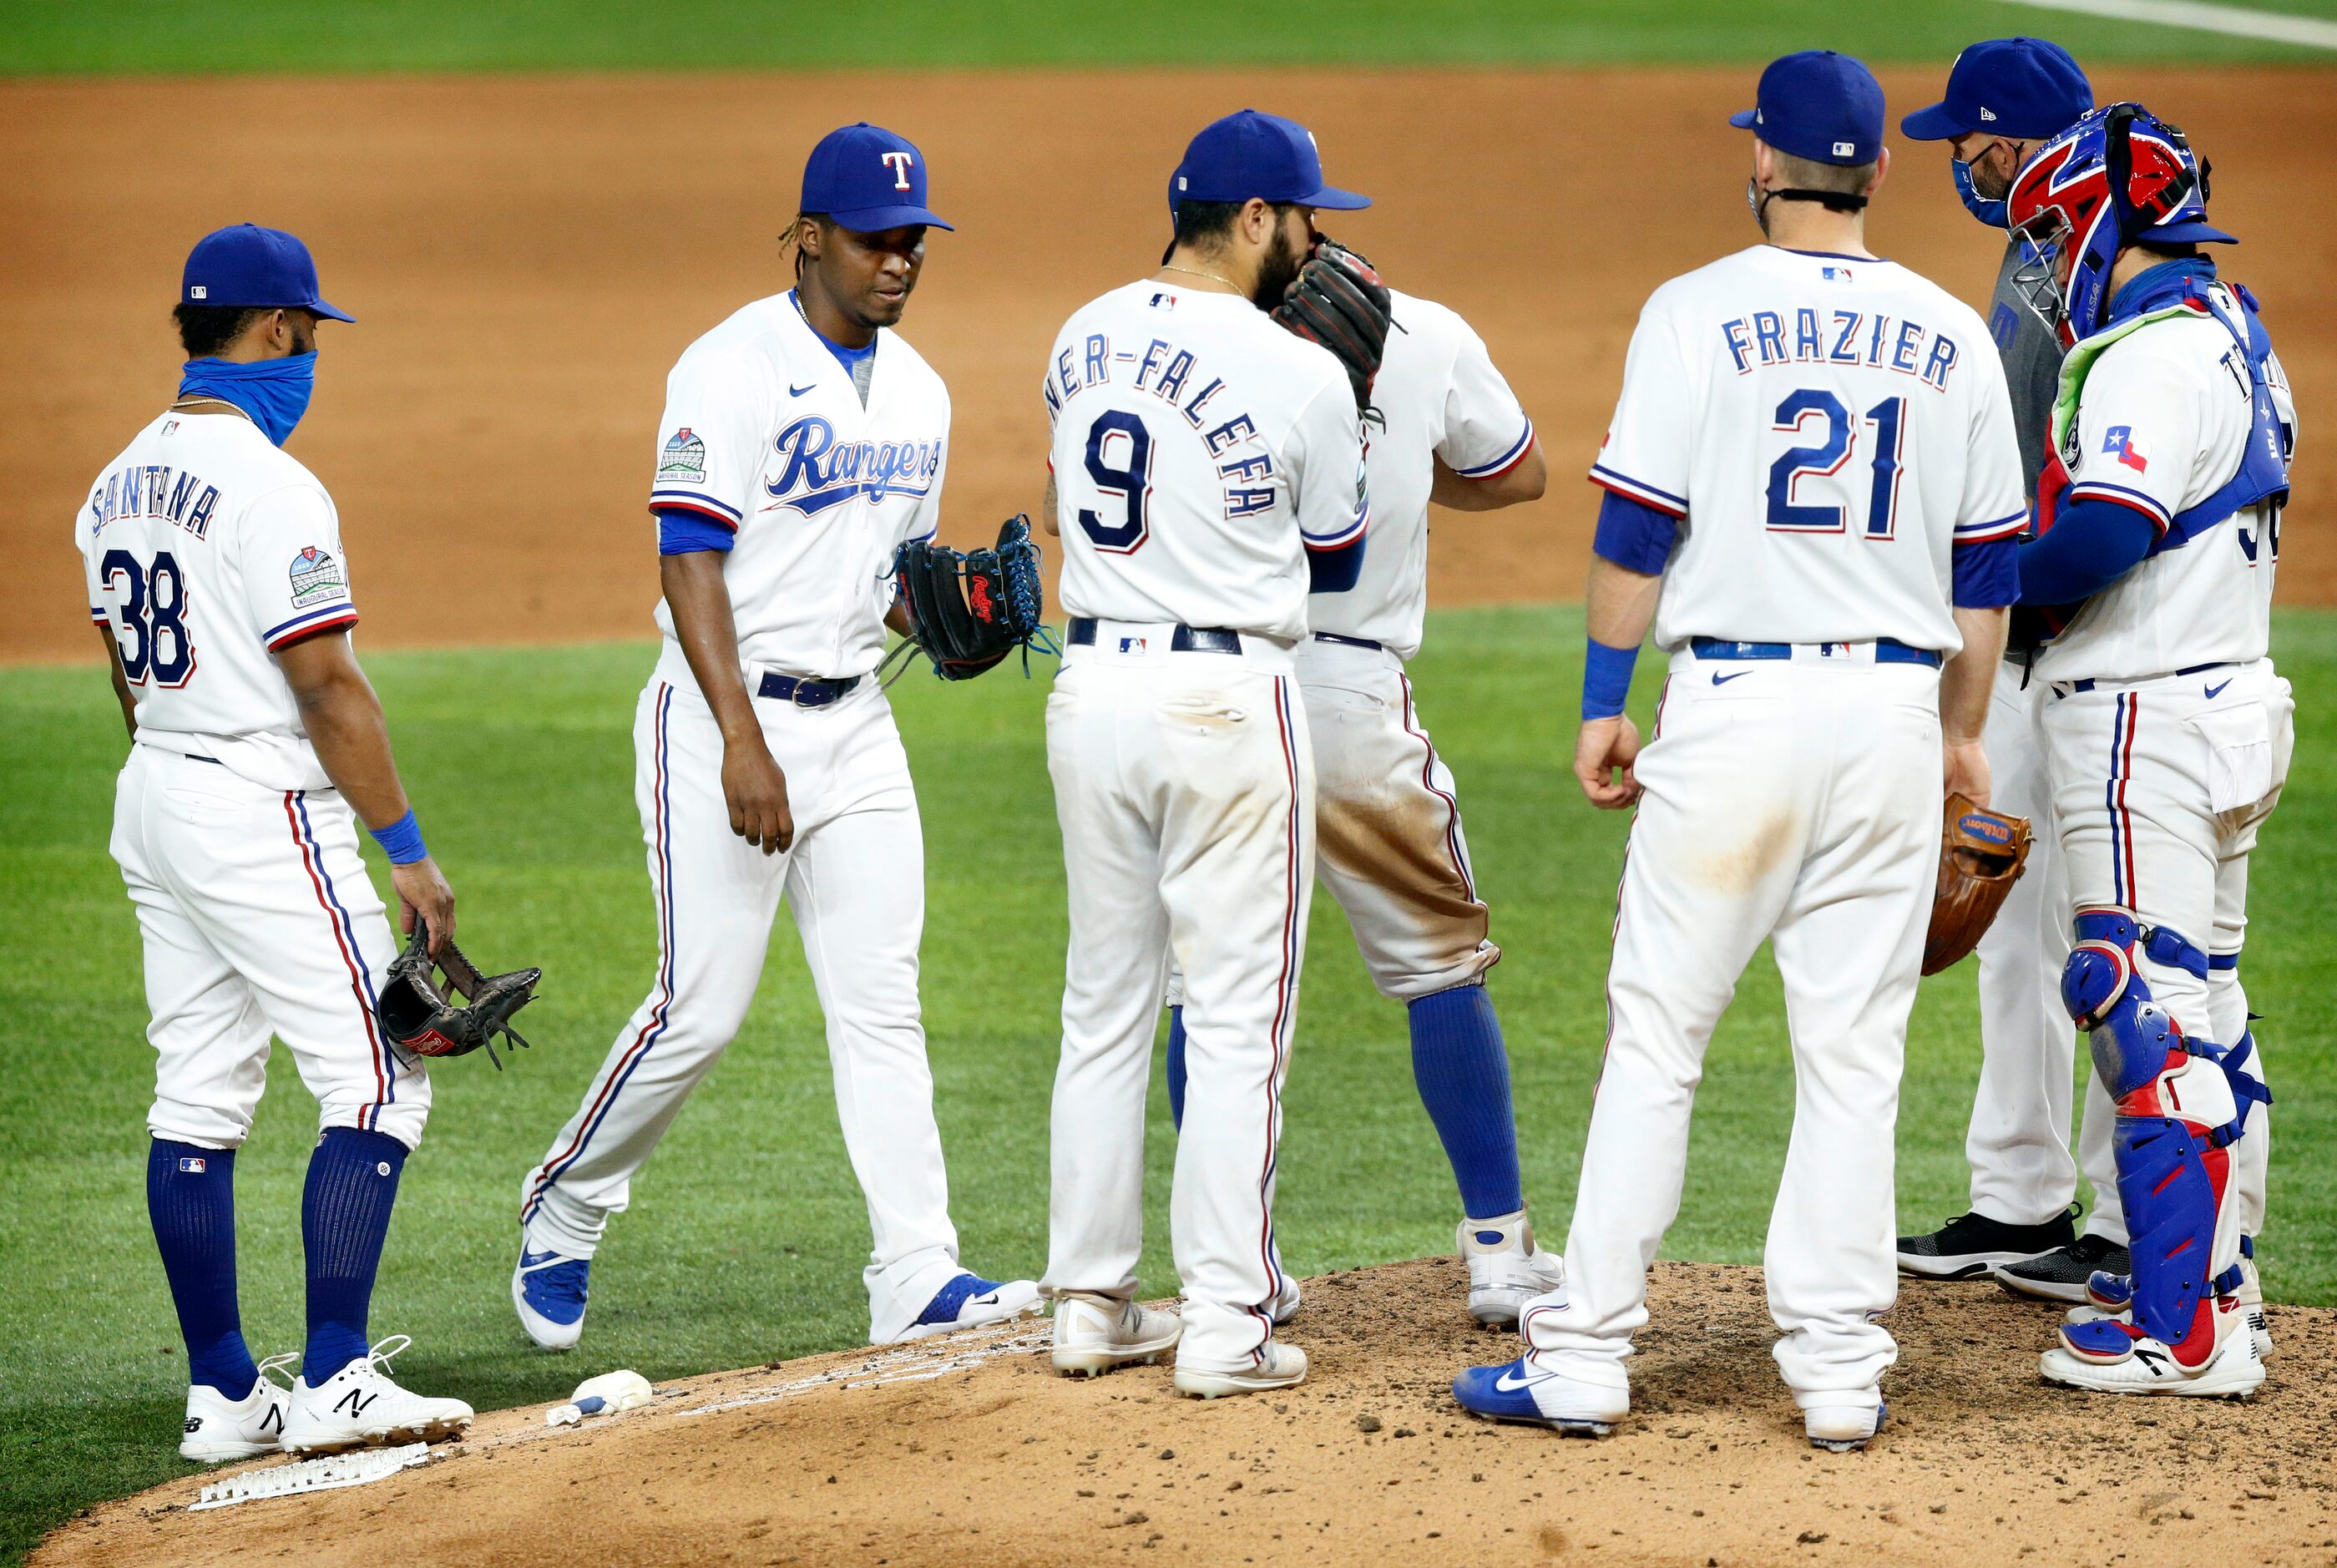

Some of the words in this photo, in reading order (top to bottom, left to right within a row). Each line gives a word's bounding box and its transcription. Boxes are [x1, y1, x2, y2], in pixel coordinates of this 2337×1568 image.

[881, 152, 914, 191] T
[1721, 308, 1959, 393] FRAZIER
[764, 414, 943, 505] Rangers
[1079, 409, 1154, 555] 9
[1765, 389, 1907, 541] 21
[92, 465, 221, 541] SANTANA
[100, 549, 198, 689] 38
[296, 592, 327, 606] INAUGURAL
[1965, 818, 2008, 841] Wilson
